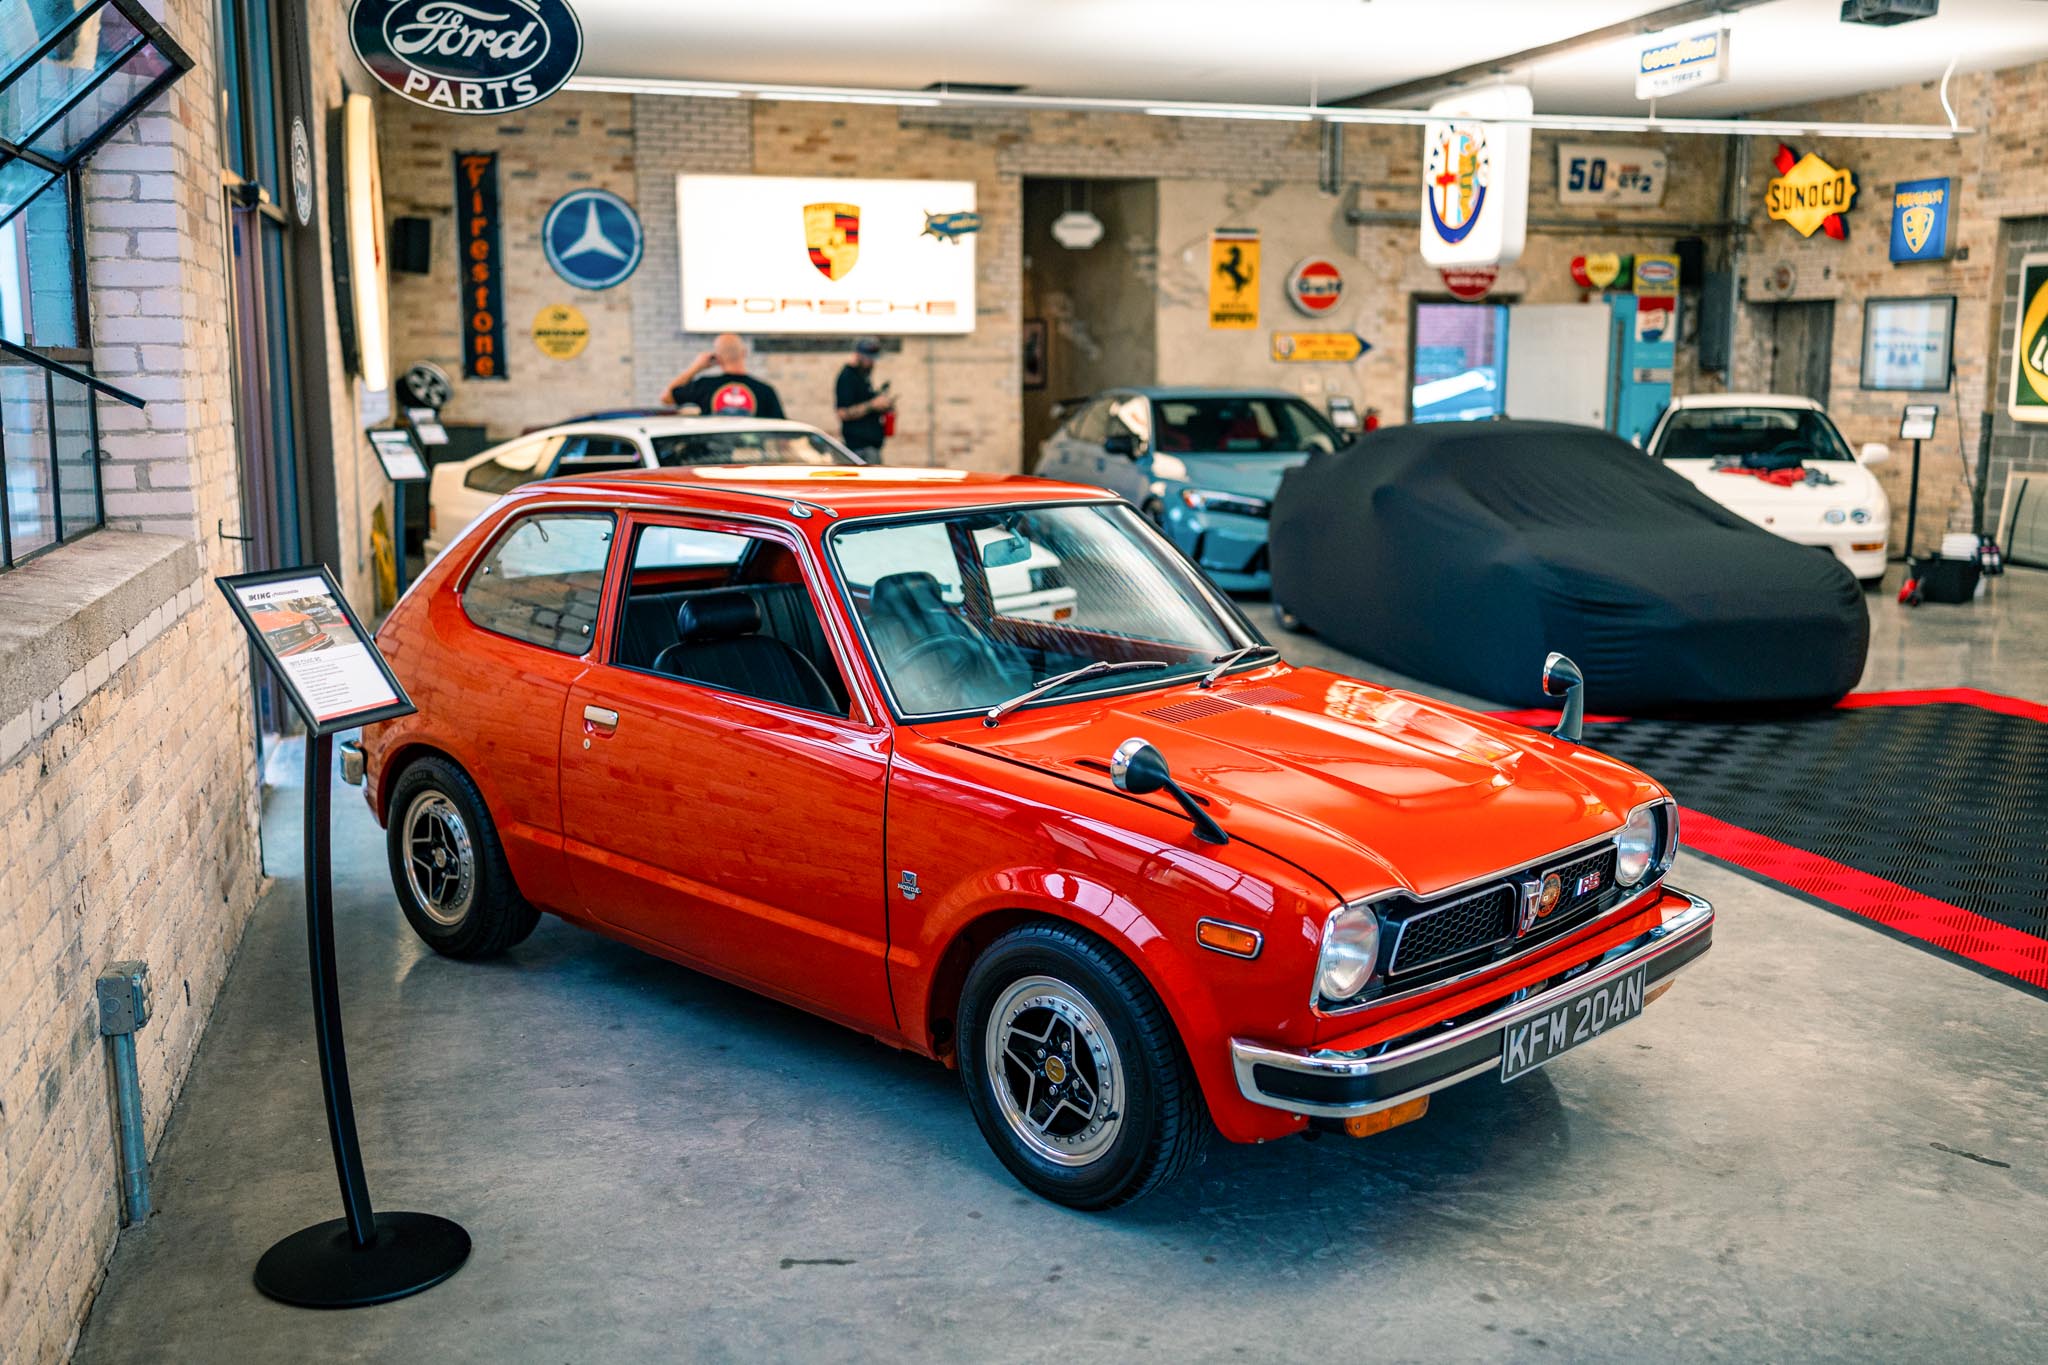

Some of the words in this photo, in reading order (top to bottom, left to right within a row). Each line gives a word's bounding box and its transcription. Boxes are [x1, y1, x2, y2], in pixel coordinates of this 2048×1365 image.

[393, 2, 538, 60] Ford
[402, 69, 538, 109] PARTS
[1568, 158, 1606, 192] 50
[1771, 175, 1845, 213] SUNOCO
[461, 155, 495, 376] Firestone
[1298, 277, 1342, 294] Gulf
[705, 298, 957, 315] PORSCHE
[1507, 1007, 1568, 1073] KFM
[1573, 971, 1642, 1043] 204N
